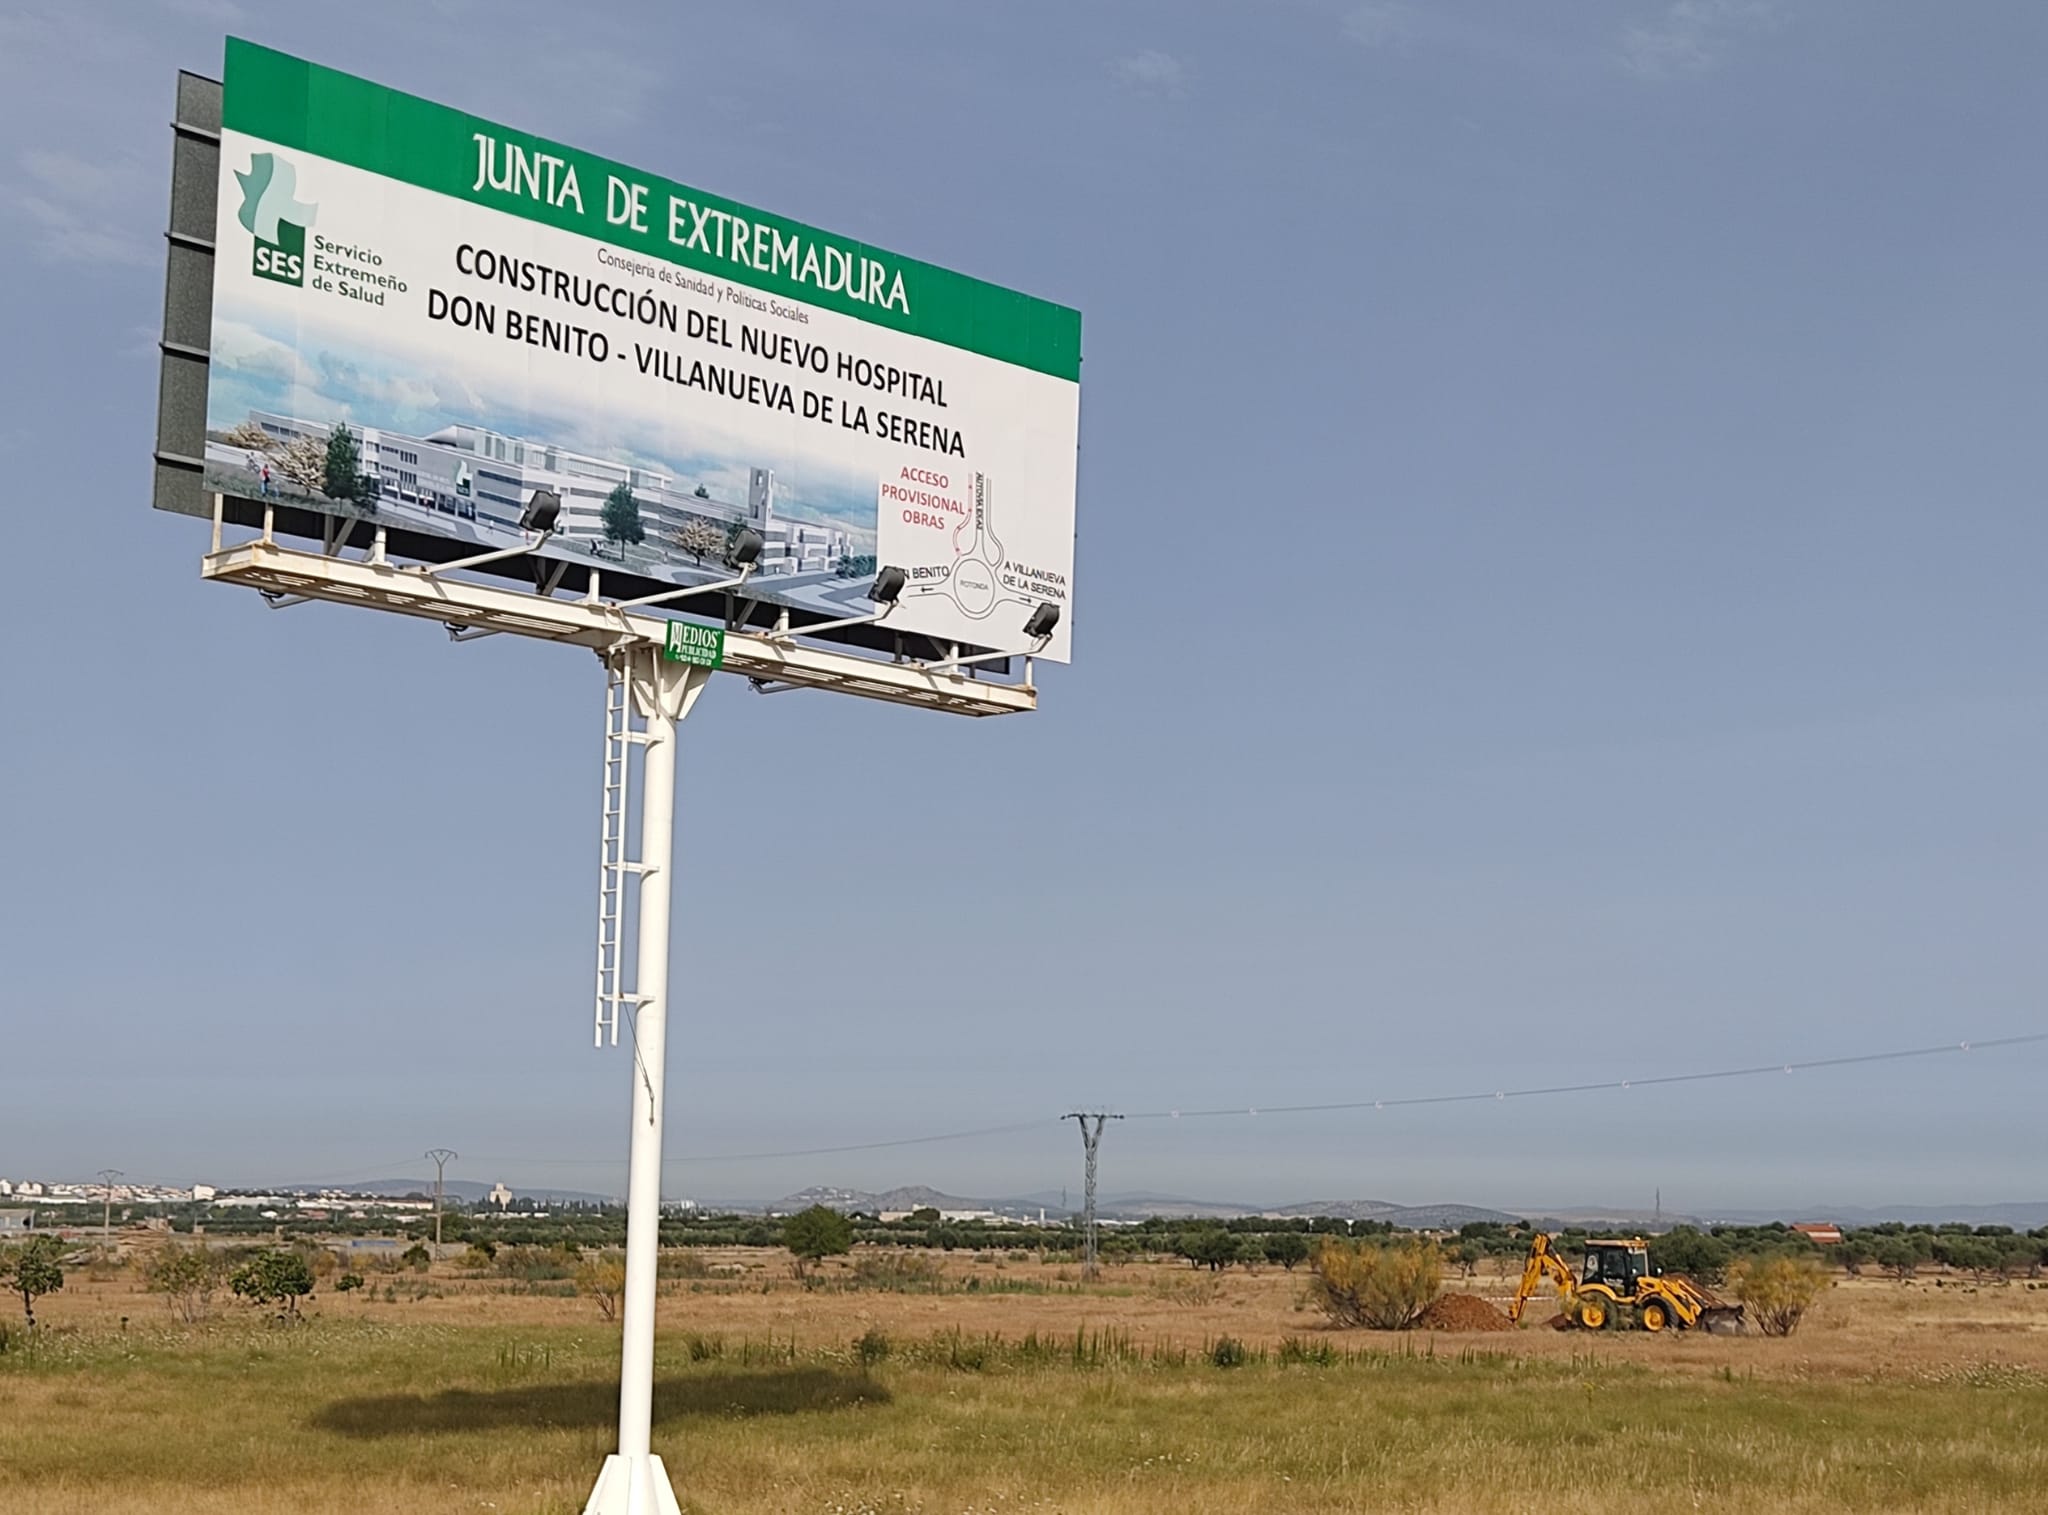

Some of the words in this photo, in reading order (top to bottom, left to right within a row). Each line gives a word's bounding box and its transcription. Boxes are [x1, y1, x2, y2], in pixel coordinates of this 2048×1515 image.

[472, 132, 585, 215] JUNTA
[606, 174, 649, 234] DE
[667, 195, 911, 315] EXTREMADURA
[256, 246, 302, 280] SES
[314, 234, 382, 266] Servicio
[313, 254, 407, 293] Extremeño
[312, 275, 333, 293] de
[338, 280, 384, 306] Salud
[658, 267, 673, 283] de
[674, 271, 715, 297] Sanidad
[717, 286, 725, 304] y
[769, 299, 810, 325] Sociales
[456, 243, 678, 333] CONSTRUCCIÓN
[687, 309, 733, 348] DEL
[741, 324, 829, 373] NUEVO
[837, 351, 948, 408] HOSPITAL
[428, 288, 495, 335] DON
[505, 309, 609, 363] BENITO
[617, 351, 627, 361] -
[634, 342, 796, 414] VILLANUEVA
[802, 390, 833, 424] DE
[841, 400, 870, 434] LA
[876, 411, 966, 459] SERENA
[900, 466, 949, 489] ACCESO
[881, 483, 966, 516] PROVISIONAL
[902, 510, 945, 530] OBRAS
[912, 566, 950, 579] BENITO
[1003, 574, 1016, 586] DE
[1018, 578, 1029, 590] LA
[1030, 582, 1066, 601] SERENA
[1004, 561, 1011, 571] A
[1013, 562, 1066, 586] VILLANUEVA
[669, 621, 719, 653] MEDIOS
